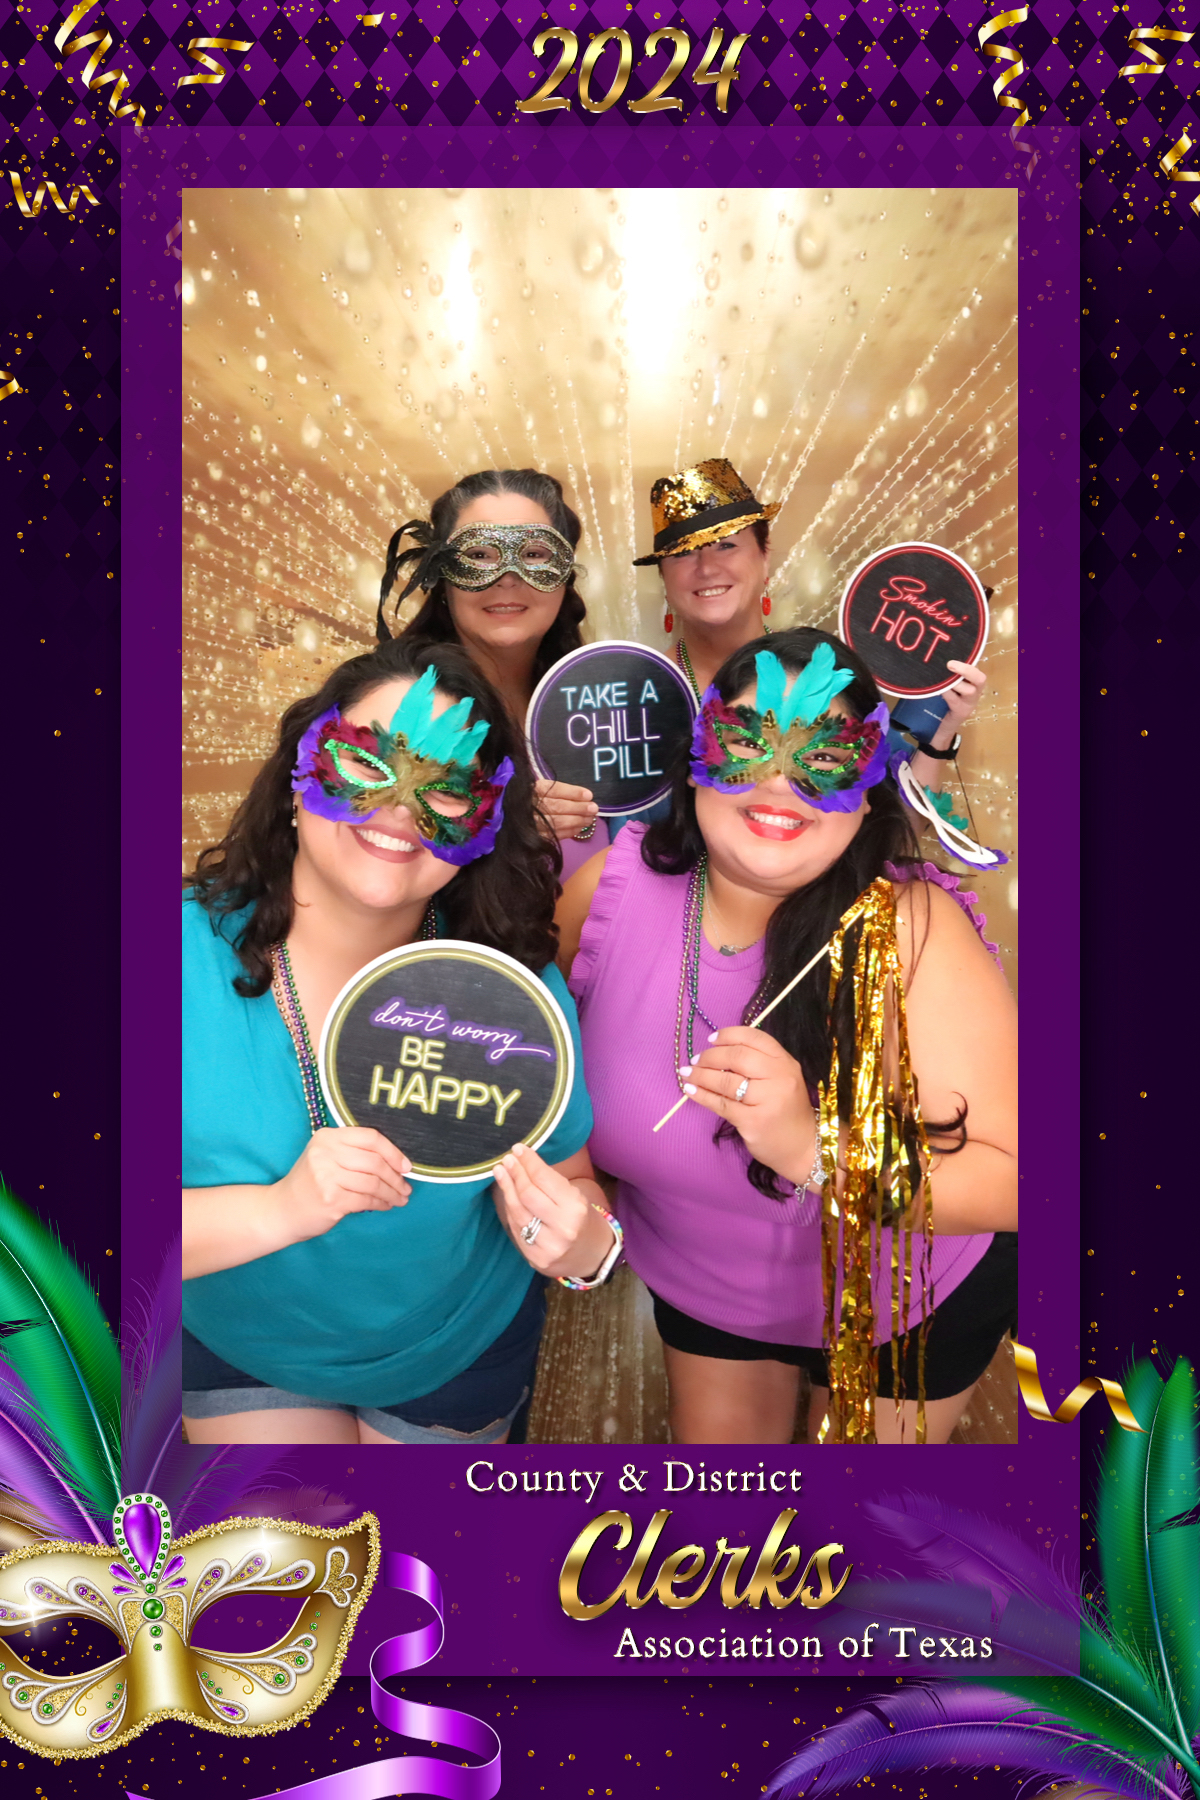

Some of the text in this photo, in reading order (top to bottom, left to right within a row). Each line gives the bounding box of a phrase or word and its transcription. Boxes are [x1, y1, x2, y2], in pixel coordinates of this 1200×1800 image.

[879, 575, 969, 627] Smokin'
[870, 600, 951, 663] HOT
[560, 679, 659, 711] TAKE A
[567, 707, 661, 747] CHILL
[593, 743, 663, 782] PILL
[373, 1000, 552, 1060] don't worry
[400, 1035, 446, 1072] BE
[369, 1064, 522, 1126] HAPPY
